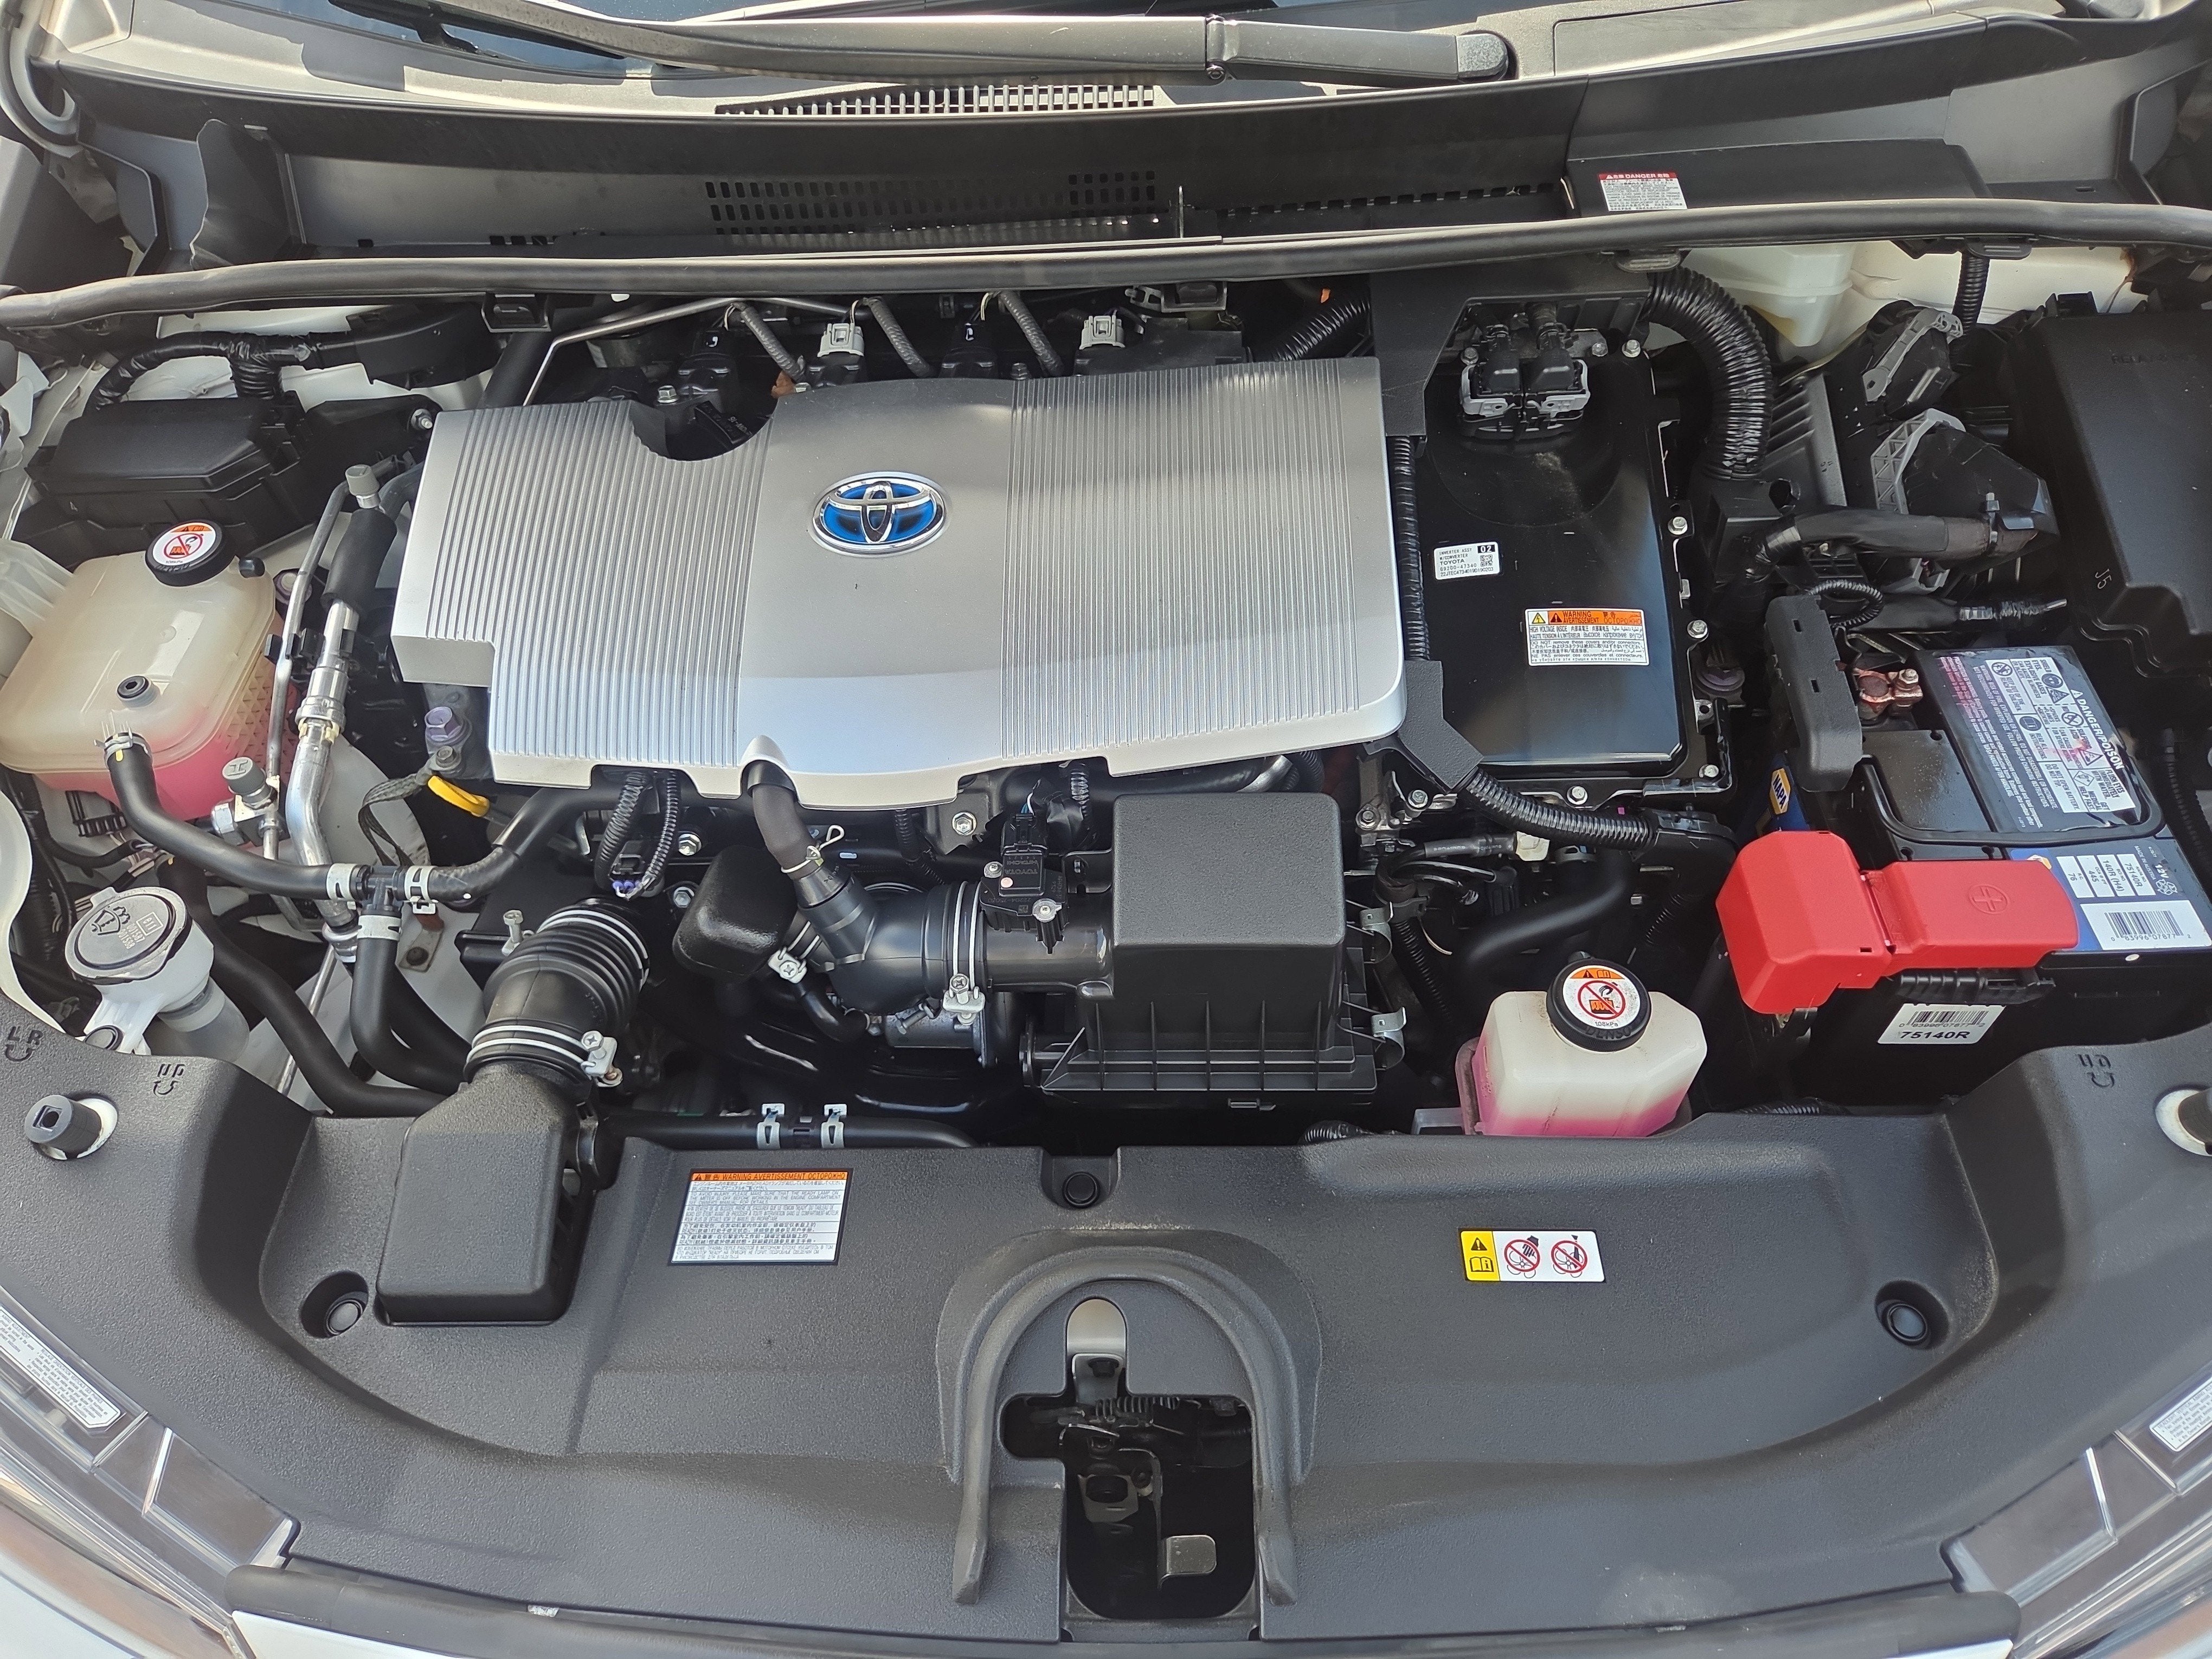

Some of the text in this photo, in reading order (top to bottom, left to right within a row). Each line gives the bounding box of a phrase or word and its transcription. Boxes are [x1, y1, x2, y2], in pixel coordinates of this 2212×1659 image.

[2078, 698, 2125, 769] DANGER/POISON
[2048, 770, 2057, 779] NOT
[2054, 770, 2064, 779] NOT
[2059, 779, 2070, 790] OPEN
[2091, 770, 2102, 781] WITH
[2098, 770, 2119, 798] IMMEDIATELY
[2105, 769, 2126, 793] FLUSH EYES
[1772, 774, 1787, 809] NAPA
[2078, 786, 2095, 811] HELP FAST.
[2086, 790, 2104, 811] MEDICAL
[2100, 802, 2110, 811] GET
[2087, 870, 2099, 882] 445
[2101, 860, 2125, 891] 140R (H4)
[2123, 863, 2143, 886] 75140R
[2155, 864, 2170, 878] 12V
[1900, 1031, 1971, 1039] 75140R
